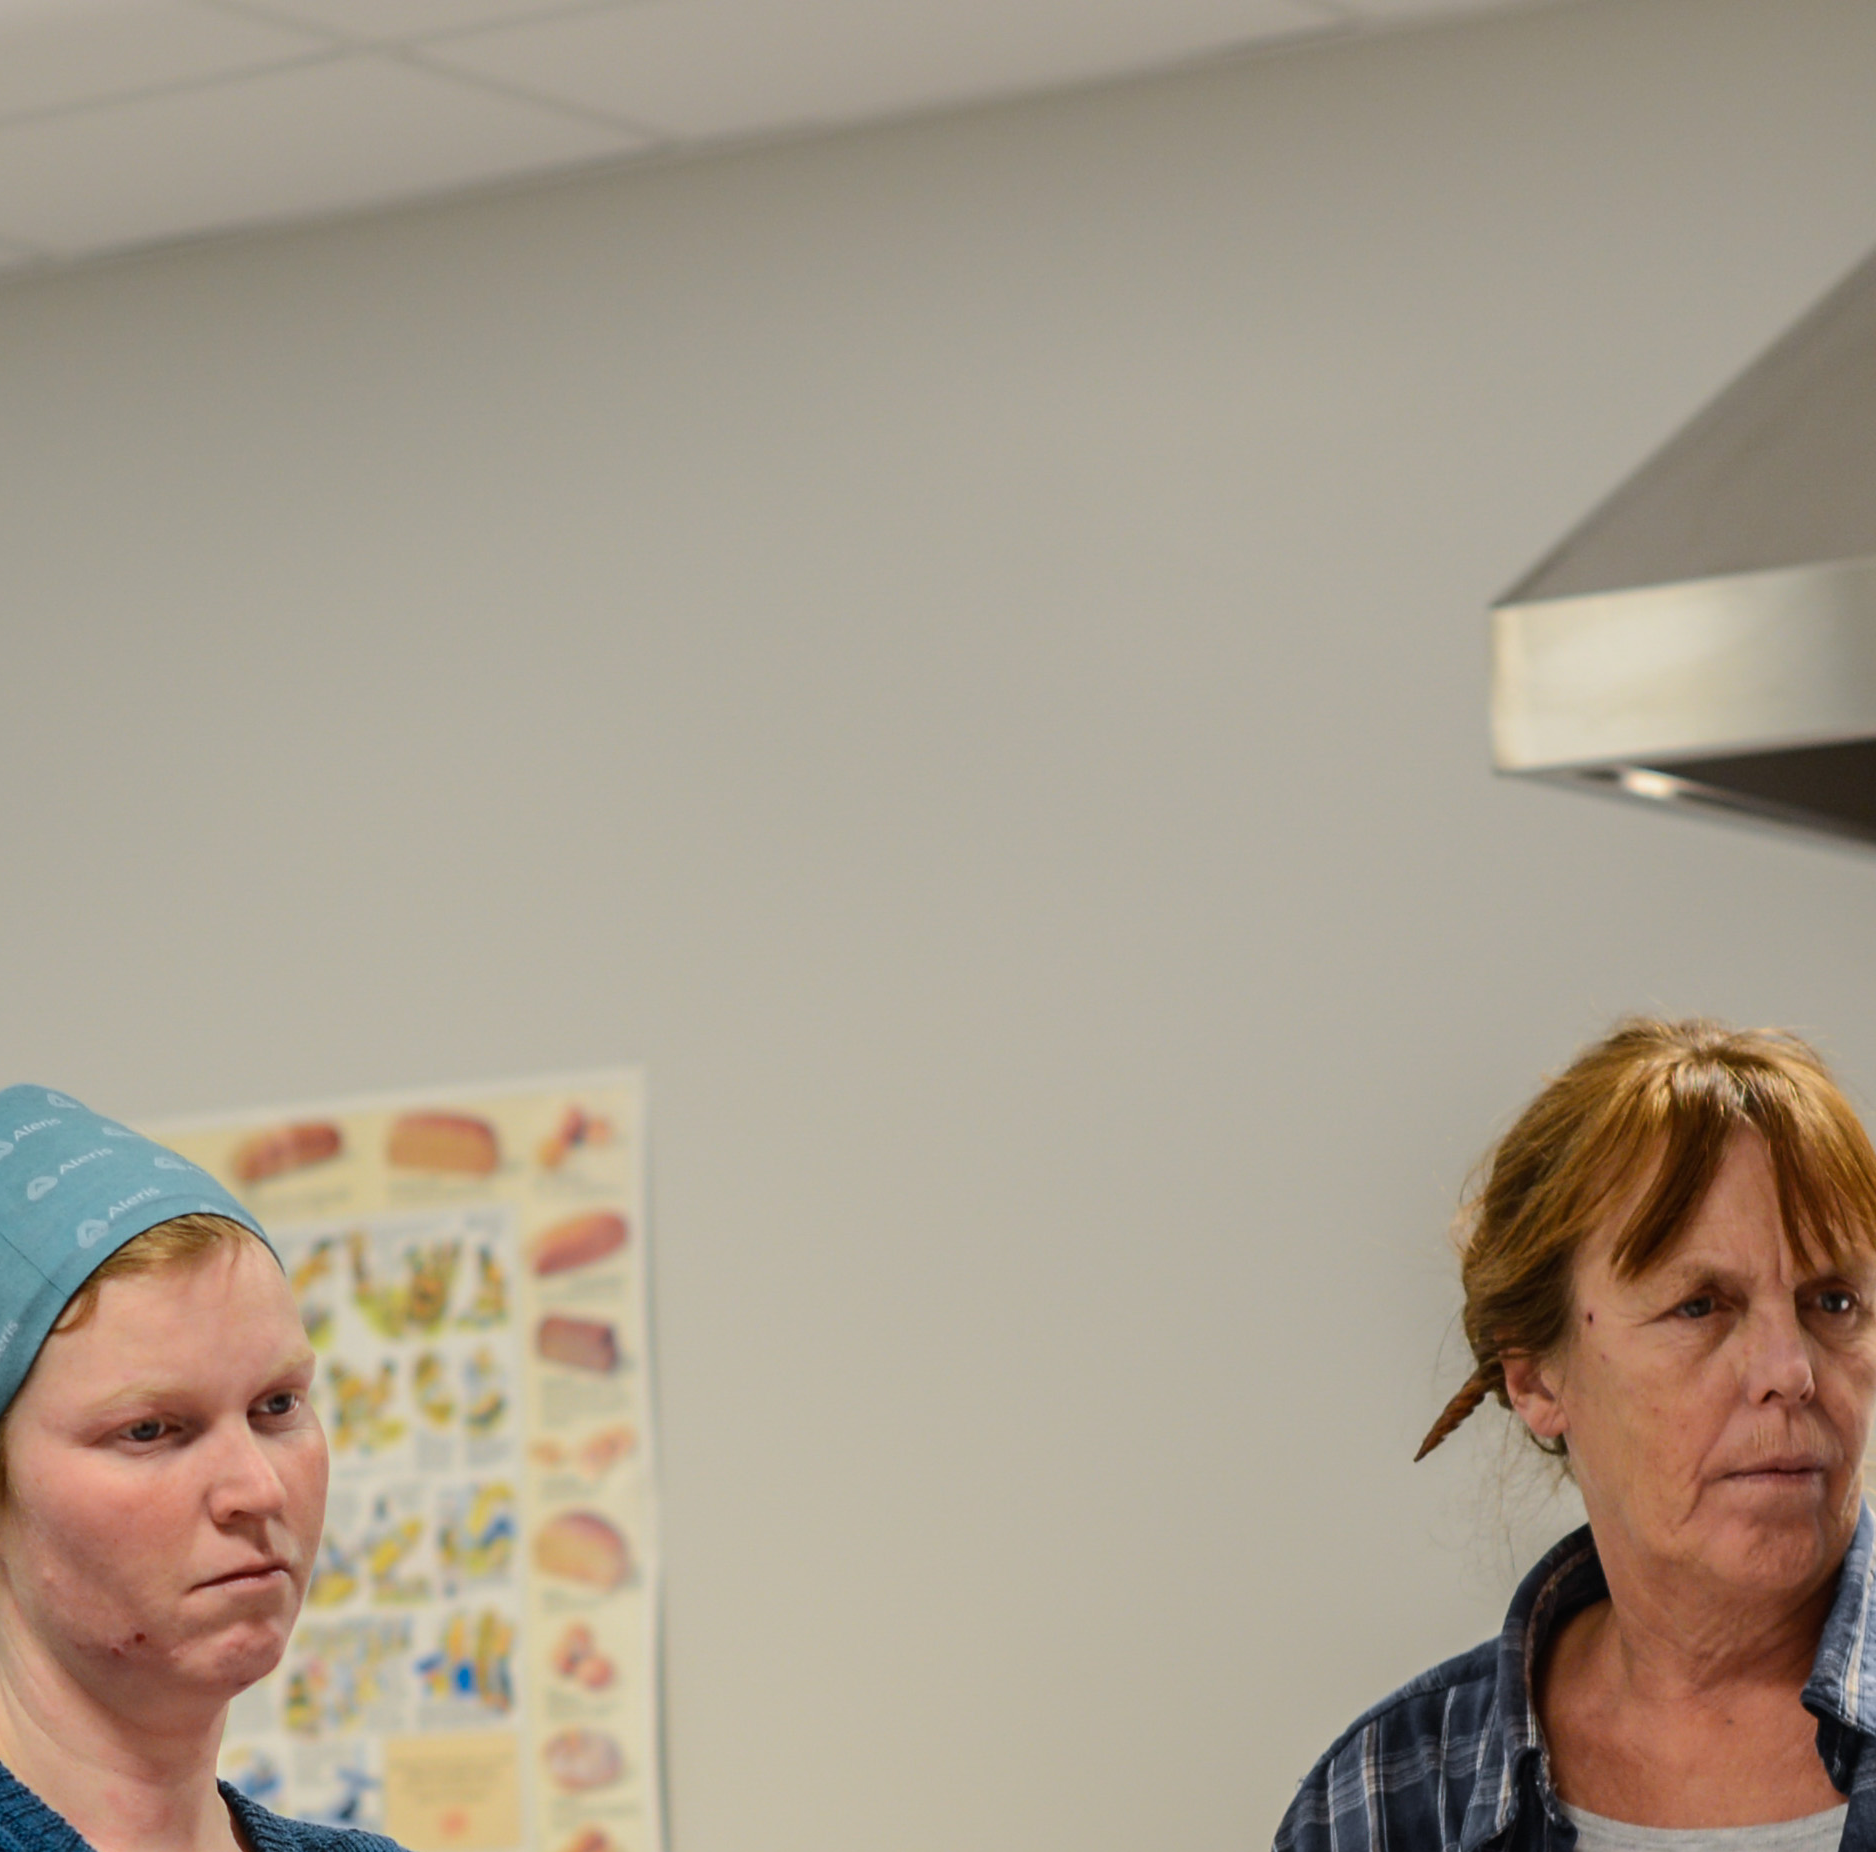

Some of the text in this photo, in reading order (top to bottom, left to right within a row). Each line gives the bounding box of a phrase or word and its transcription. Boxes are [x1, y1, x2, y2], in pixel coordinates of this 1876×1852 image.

[13, 1117, 62, 1141] Aleris
[59, 1147, 113, 1175] Aleris
[108, 1185, 160, 1219] Aleris
